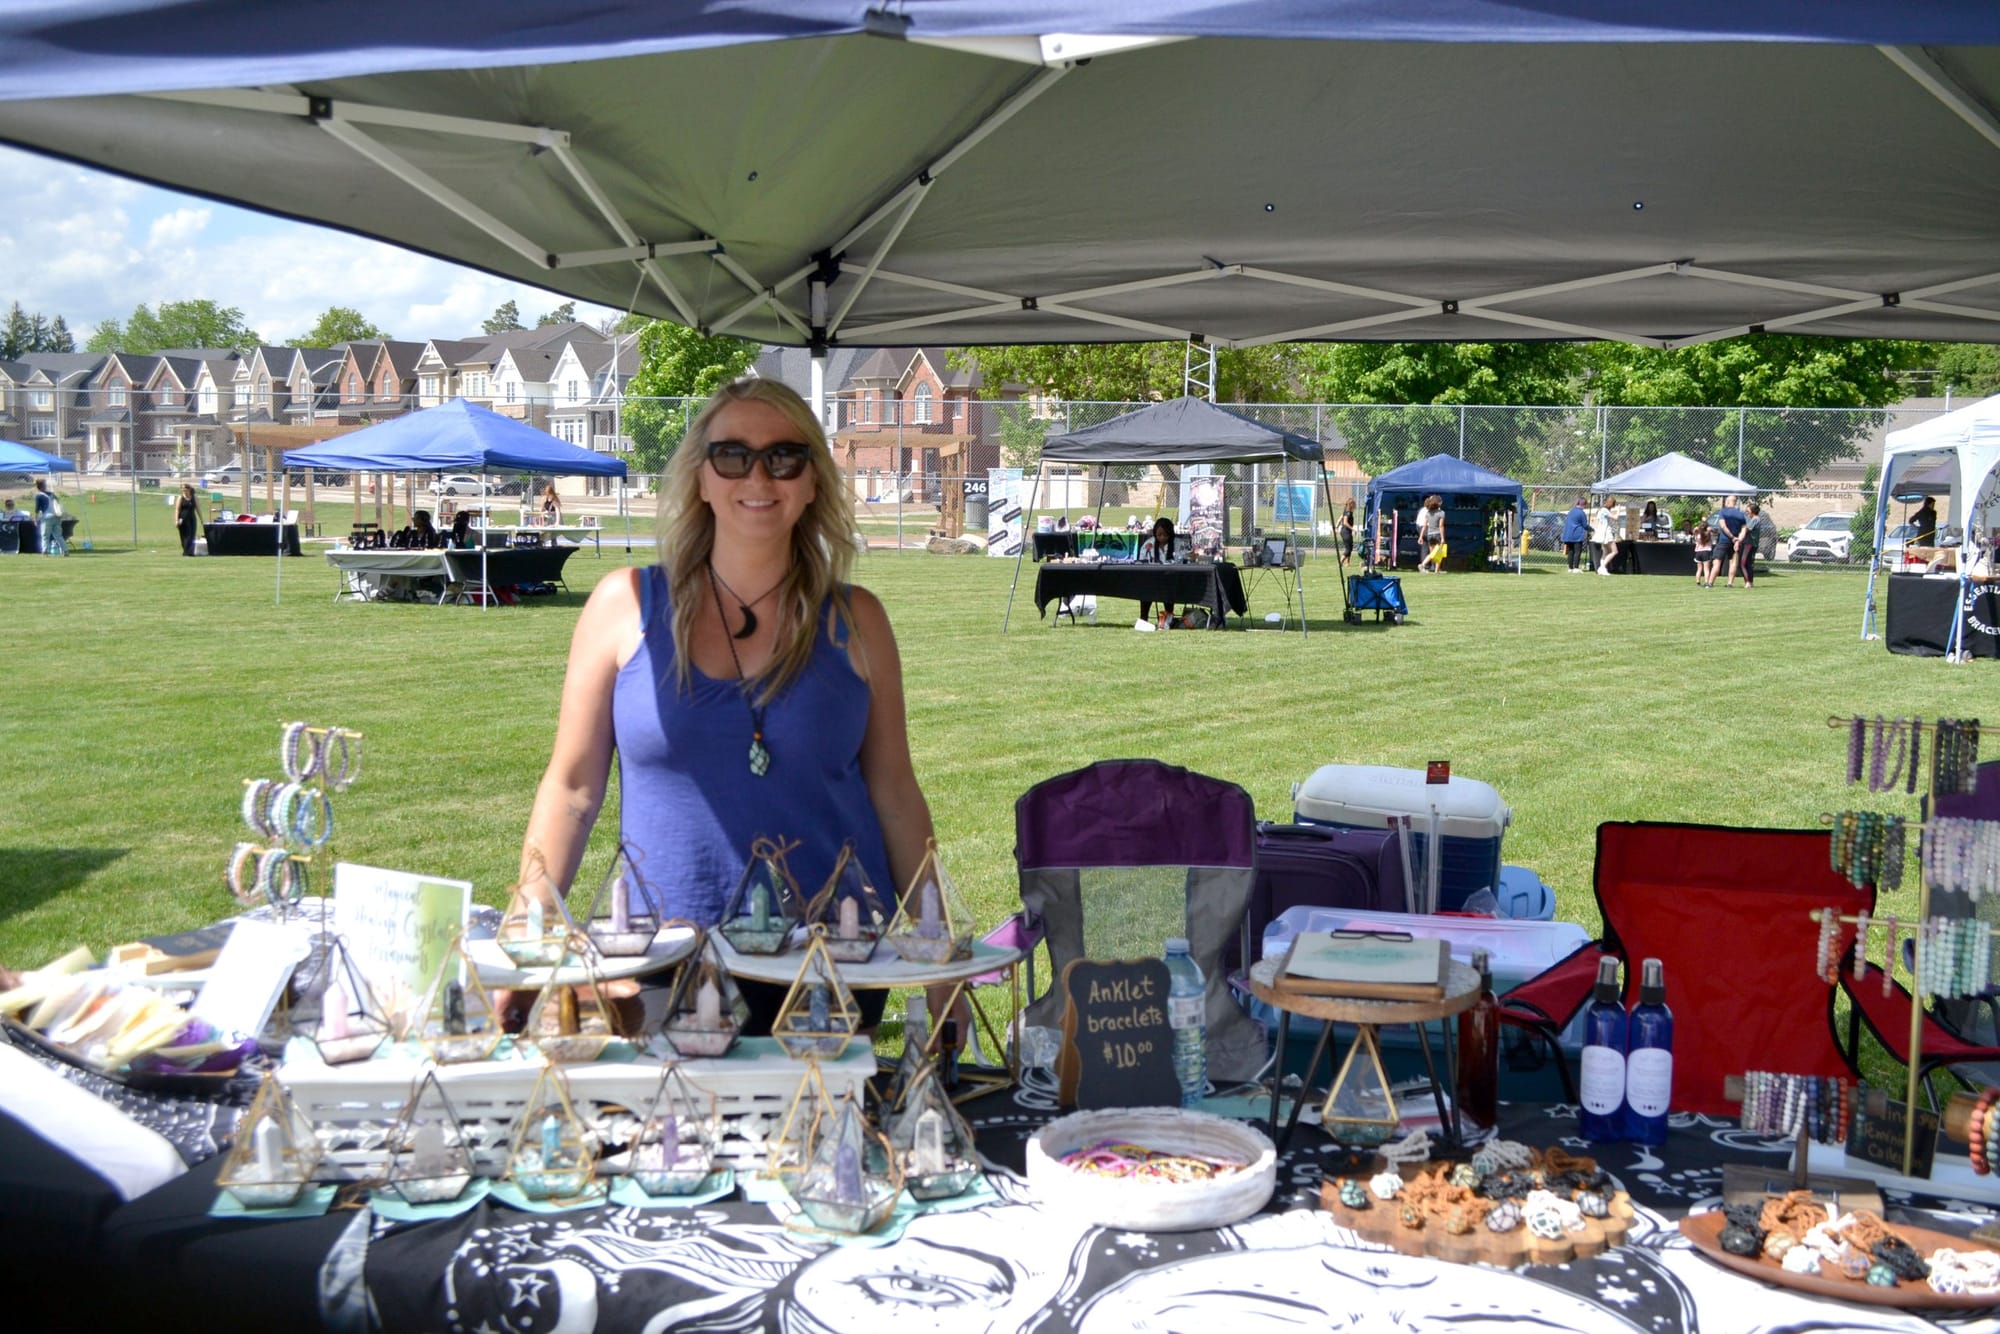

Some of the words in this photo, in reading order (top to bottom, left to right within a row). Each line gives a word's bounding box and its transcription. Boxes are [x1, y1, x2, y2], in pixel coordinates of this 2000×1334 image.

[964, 482, 987, 493] 246
[1808, 482, 1839, 491] County
[1087, 1005, 1163, 1033] bracelets
